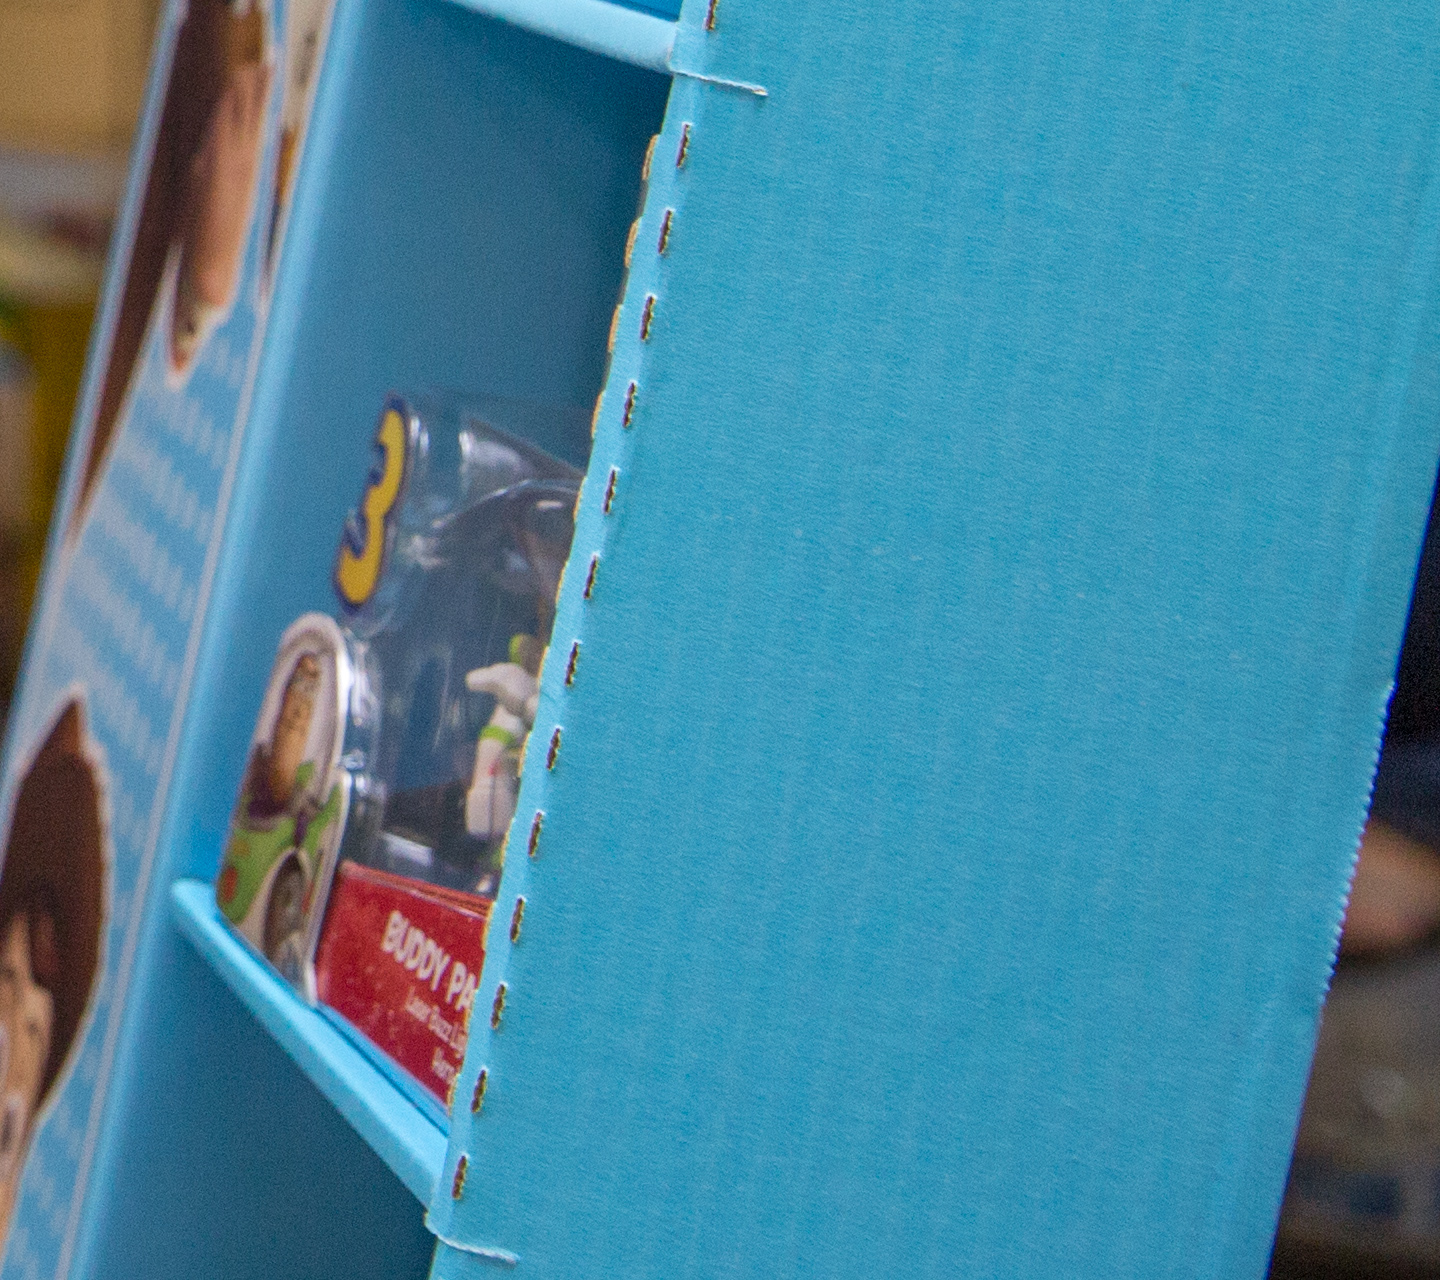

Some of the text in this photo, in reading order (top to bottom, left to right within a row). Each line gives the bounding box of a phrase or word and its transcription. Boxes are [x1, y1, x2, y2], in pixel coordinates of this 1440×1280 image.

[335, 395, 409, 612] 3
[382, 909, 478, 1012] BUDDY PA
